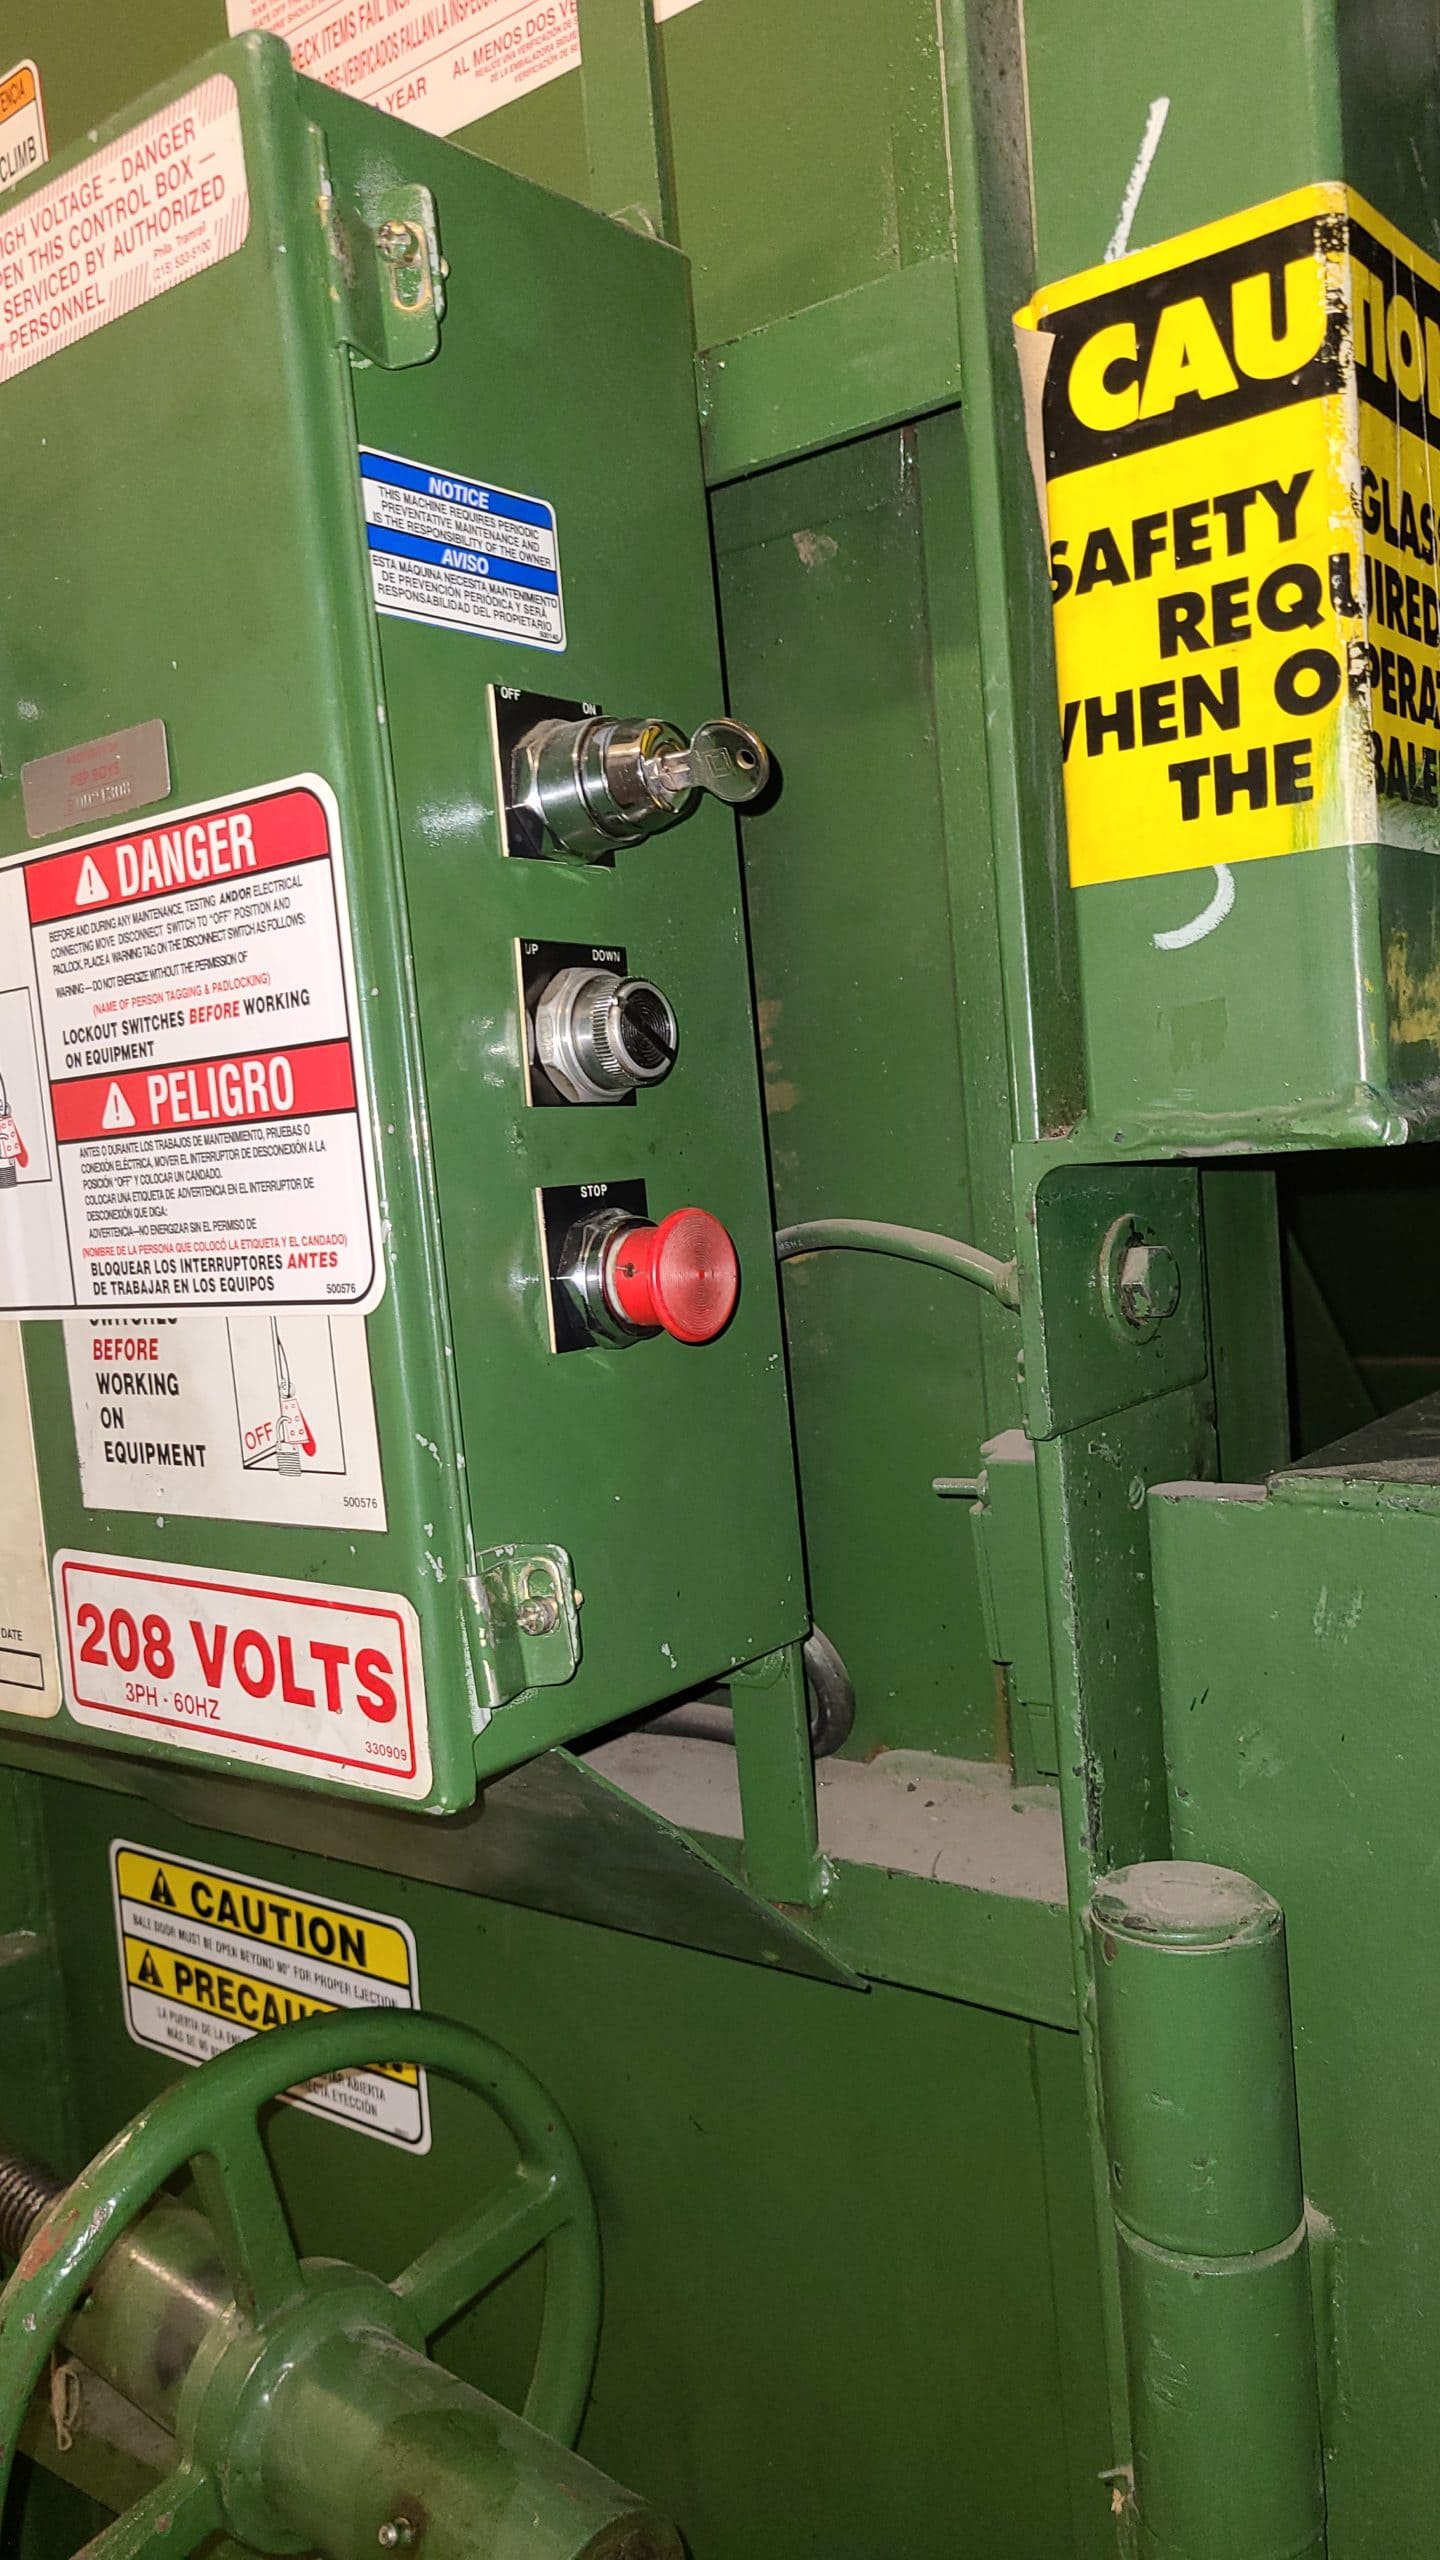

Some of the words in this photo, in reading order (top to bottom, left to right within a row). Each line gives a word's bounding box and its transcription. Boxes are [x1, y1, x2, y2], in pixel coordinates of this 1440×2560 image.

[321, 11, 358, 57] ITEMS
[400, 9, 435, 56] FALLAN
[453, 56, 469, 80] AL
[473, 26, 522, 67] MENOS
[526, 8, 556, 38] DOS
[386, 76, 427, 112] YEAR
[0, 135, 37, 183] CLIMB
[30, 175, 104, 238] VOLTAGE
[121, 117, 195, 183] DANGER
[28, 235, 64, 274] THIS
[69, 184, 151, 251] CONTROL
[155, 154, 193, 199] BOX
[4, 260, 80, 324] SERVICED
[85, 243, 106, 277] BY
[113, 174, 225, 261] AUTHORIZED
[10, 282, 105, 352] PERSONNEL
[428, 476, 490, 510] NOTICE
[378, 485, 400, 502] THIS
[403, 492, 448, 514] MACHINE
[448, 505, 496, 528] REQUIRES
[498, 519, 540, 541] PERIODIC
[381, 500, 454, 530] PREVENTATIVE
[454, 520, 520, 548] MAINTENANCE
[521, 539, 541, 553] AND
[373, 511, 383, 523] IS
[384, 514, 405, 529] THE
[406, 520, 484, 548] RESPONSIBILITY
[486, 541, 498, 552] OF
[500, 545, 518, 559] THE
[519, 550, 552, 567] OWNER
[1049, 469, 1315, 605] SAFETY
[381, 570, 396, 583] DE
[440, 548, 490, 575] AVISO
[373, 555, 397, 570] ESTA
[444, 571, 487, 591] NECESITA
[489, 582, 558, 609] MANTENIMIENTO
[377, 583, 472, 614] RESPONSABILIDAD
[473, 604, 492, 618] DEL
[494, 609, 553, 632] PROPIETARIO
[500, 686, 521, 700] OFF
[582, 702, 597, 715] ON
[1169, 738, 1315, 822] THE
[115, 812, 257, 898] DANGER
[49, 927, 75, 943] BEFORE
[76, 923, 90, 937] AND
[91, 917, 117, 934] DURING
[117, 914, 131, 928] ANY
[185, 895, 217, 912] TESTING
[253, 875, 304, 898] ELECTRICAL
[51, 940, 95, 960] CONNECTING
[95, 934, 116, 951] MOVE
[118, 924, 164, 945] DISCONNECT
[166, 917, 197, 935] SWITCH
[196, 914, 208, 928] TO
[233, 901, 272, 920] POSITION
[273, 896, 292, 912] AND
[111, 946, 143, 964] WARNING
[143, 943, 157, 957] TAG
[168, 937, 182, 952] THE
[181, 928, 227, 949] DISCONNECT
[227, 922, 257, 940] SWITCH
[524, 943, 539, 955] UP
[592, 949, 621, 962] DOWN
[149, 964, 181, 981] WITHOUT
[237, 950, 248, 964] OF
[118, 998, 130, 1012] OF
[131, 992, 164, 1010] PERSON
[165, 984, 202, 1003] TAGGING
[211, 971, 272, 996] PADLOCKING)
[62, 1021, 118, 1046] LOCKOUT
[121, 1010, 186, 1036] SWITCHES
[189, 1001, 241, 1025] BEFORE
[243, 989, 311, 1016] WORKING
[65, 1052, 83, 1069] ON
[85, 1040, 155, 1067] EQUIPMENT
[146, 1055, 295, 1126] PELIGRO
[79, 1146, 101, 1159] ANTES
[108, 1141, 139, 1156] DURANTE
[139, 1139, 154, 1153] LOS
[154, 1135, 192, 1152] TRABAJOS
[192, 1134, 204, 1147] DE
[266, 1124, 303, 1140] PRUEBAS
[154, 1153, 180, 1168] MOVER
[190, 1147, 241, 1165] INTERRUPTOR
[84, 1193, 117, 1207] COLOCAR
[117, 1190, 132, 1203] UNA
[132, 1187, 165, 1203] ETIQUETA
[177, 1182, 227, 1200] ADVERTENCIA
[248, 1177, 304, 1194] INTERRUPTOR
[303, 1177, 316, 1190] DE
[139, 1170, 174, 1186] COLOCAR
[580, 1184, 608, 1198] STOP
[133, 1206, 149, 1219] QUE
[149, 1222, 190, 1236] ENERGIZAR
[212, 1218, 246, 1232] PERMISO
[90, 1259, 152, 1277] BLOQUEAR
[154, 1257, 178, 1274] LOS
[180, 1253, 284, 1273] INTERRUPTORES
[286, 1250, 339, 1270] ANTES
[139, 1242, 174, 1256] PERSONA
[240, 1236, 281, 1250] ETIQUETA
[301, 1233, 348, 1249] CANDADO)
[93, 1281, 109, 1296] DE
[111, 1277, 171, 1296] TRABAJAR
[173, 1277, 190, 1294] EN
[193, 1275, 217, 1293] LOS
[219, 1273, 275, 1292] EQUIPOS
[326, 1283, 357, 1294] 500576
[92, 1338, 160, 1362] BEFORE
[95, 1372, 181, 1397] WORKING
[99, 1406, 125, 1430] ON
[244, 1421, 275, 1451] OFF
[103, 1441, 207, 1469] EQUIPMENT
[342, 1495, 379, 1510] 500576
[1, 1627, 24, 1642] DATE
[76, 1602, 176, 1680] 208
[188, 1619, 399, 1724] VOLTS
[125, 1681, 159, 1708] 3PH
[173, 1691, 221, 1721] 60HZ
[364, 1740, 408, 1762] 330909
[190, 1880, 368, 1968] CAUTION
[178, 1928, 201, 1946] MUST
[240, 1947, 275, 1971] BEYOND
[293, 1965, 312, 1984] FOR
[314, 1972, 352, 1998] PROPER
